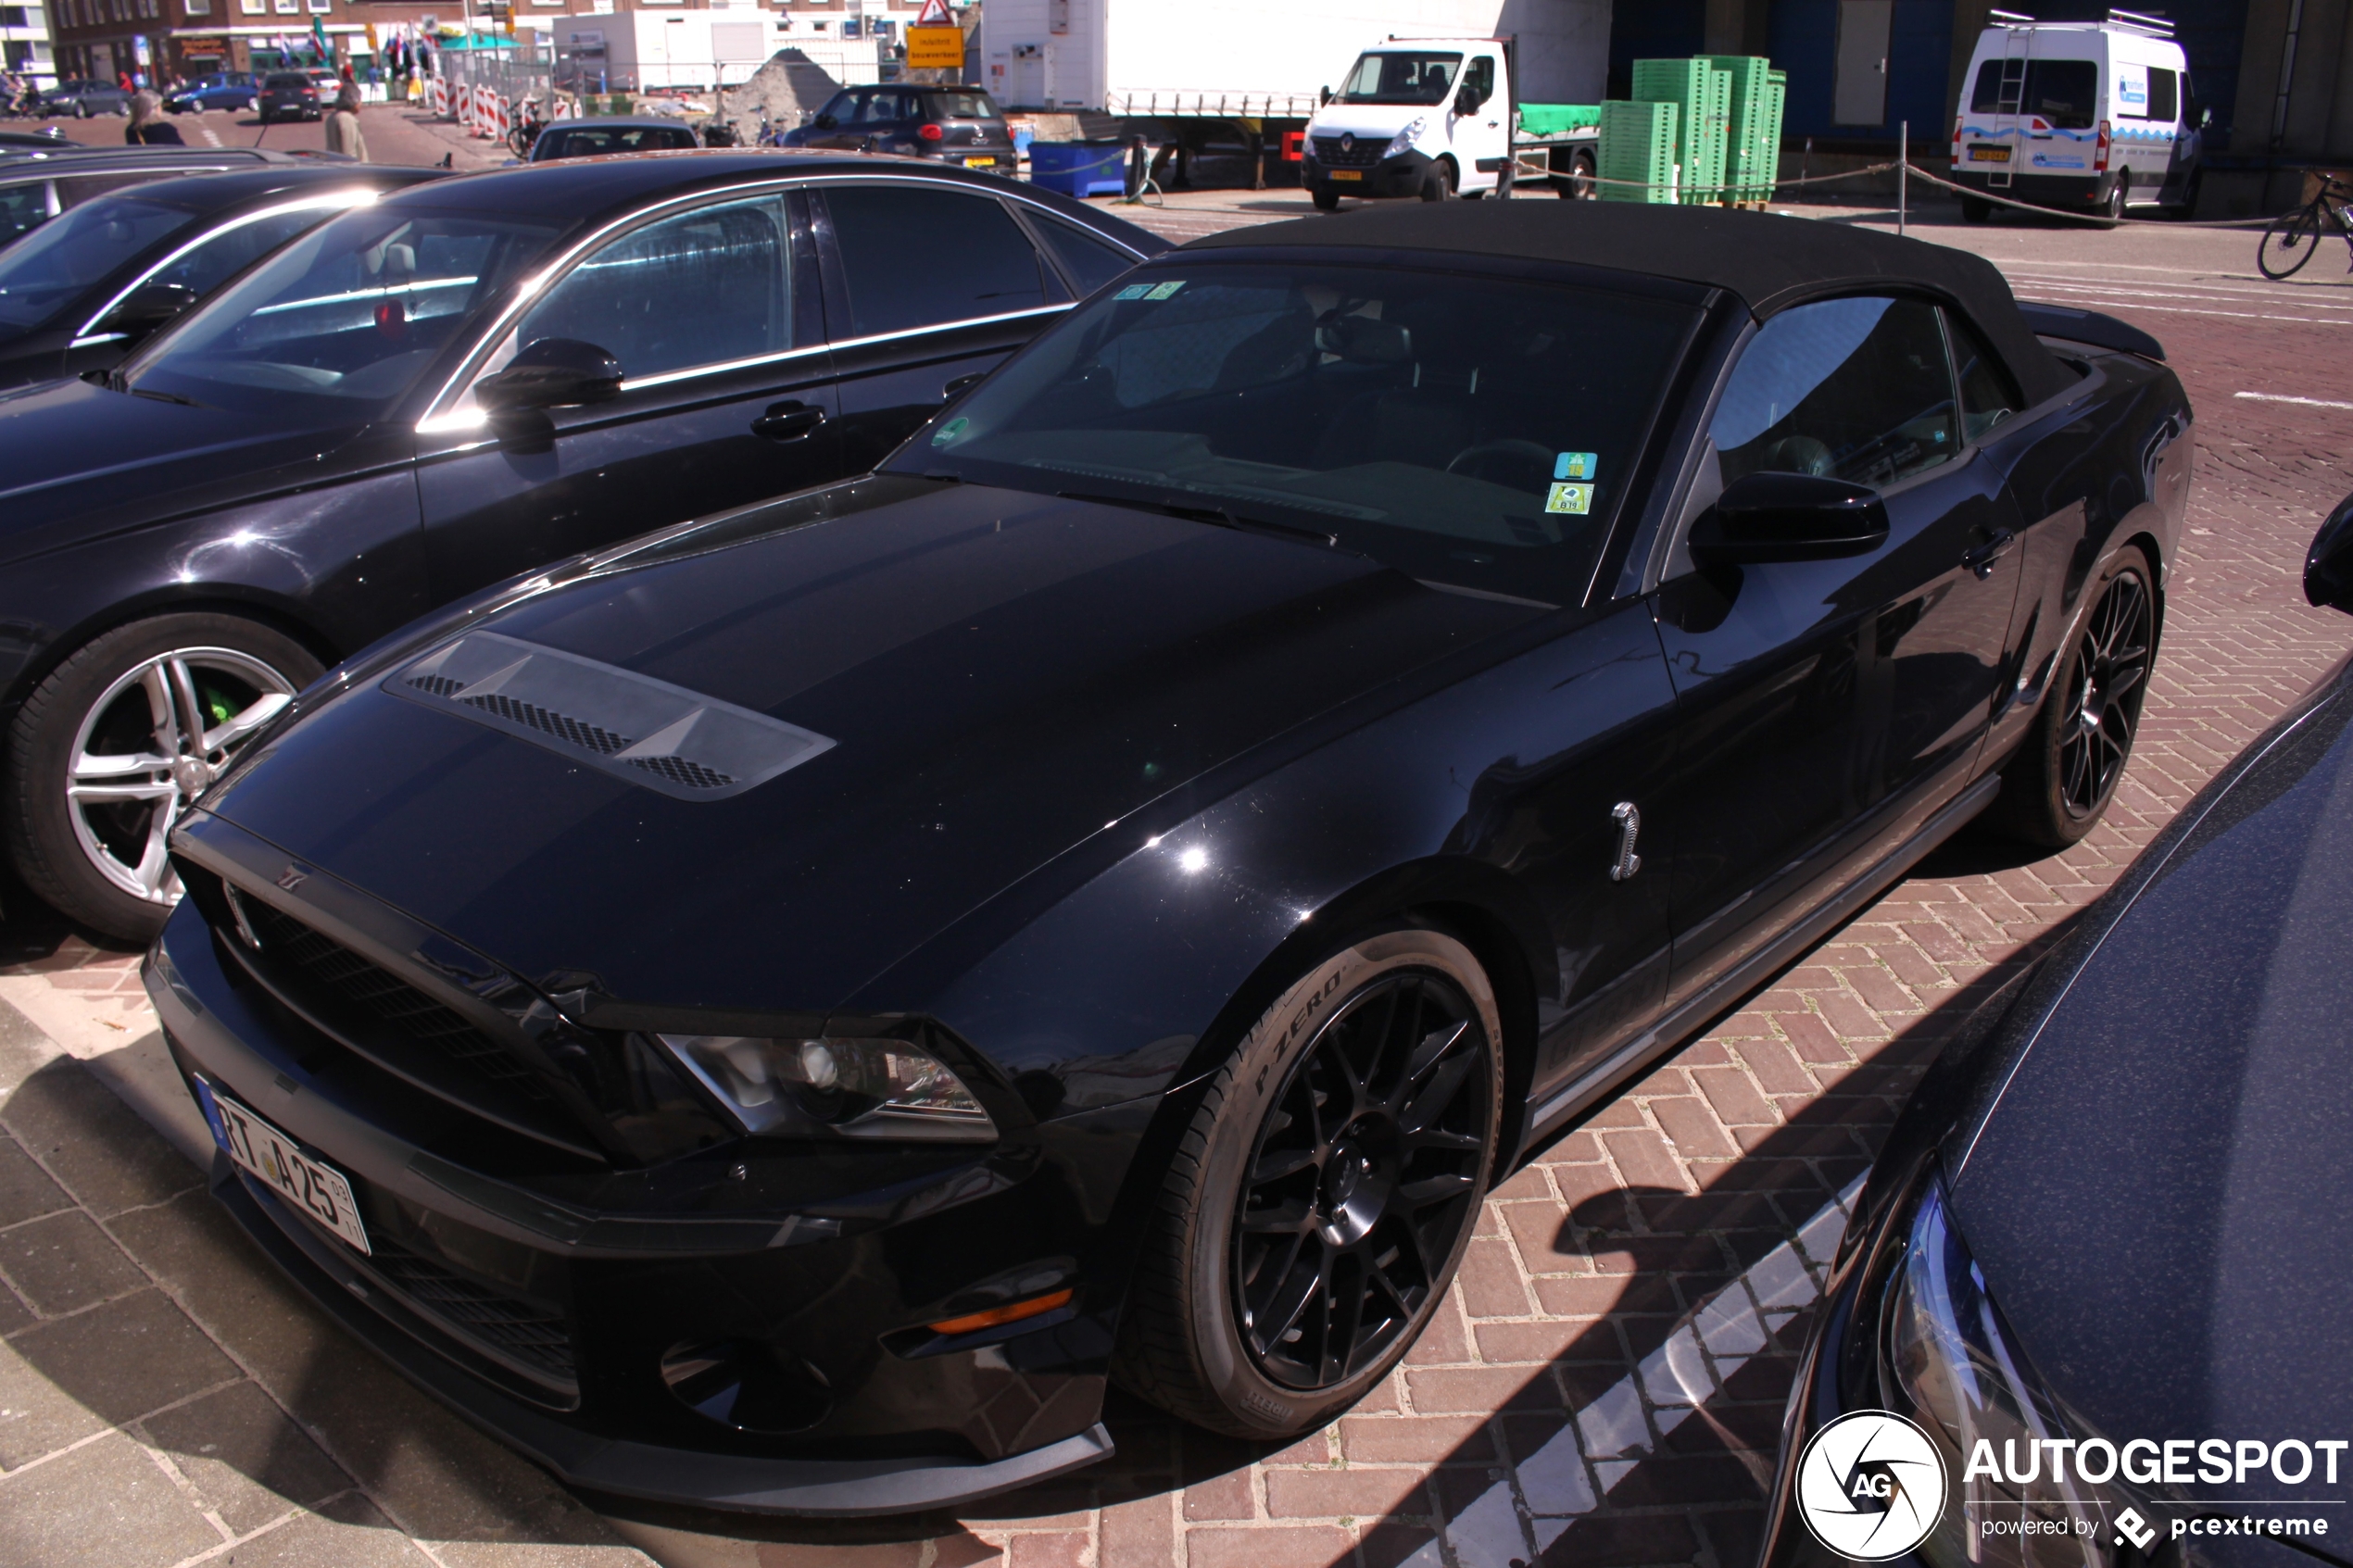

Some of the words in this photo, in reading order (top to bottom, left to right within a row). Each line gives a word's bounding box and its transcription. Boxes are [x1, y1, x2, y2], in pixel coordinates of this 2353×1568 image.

[2047, 154, 2083, 162] maritiem
[1567, 464, 1584, 477] 19
[1273, 970, 1341, 1064] ZERO
[217, 1103, 258, 1169] RT
[271, 1138, 339, 1225] A25
